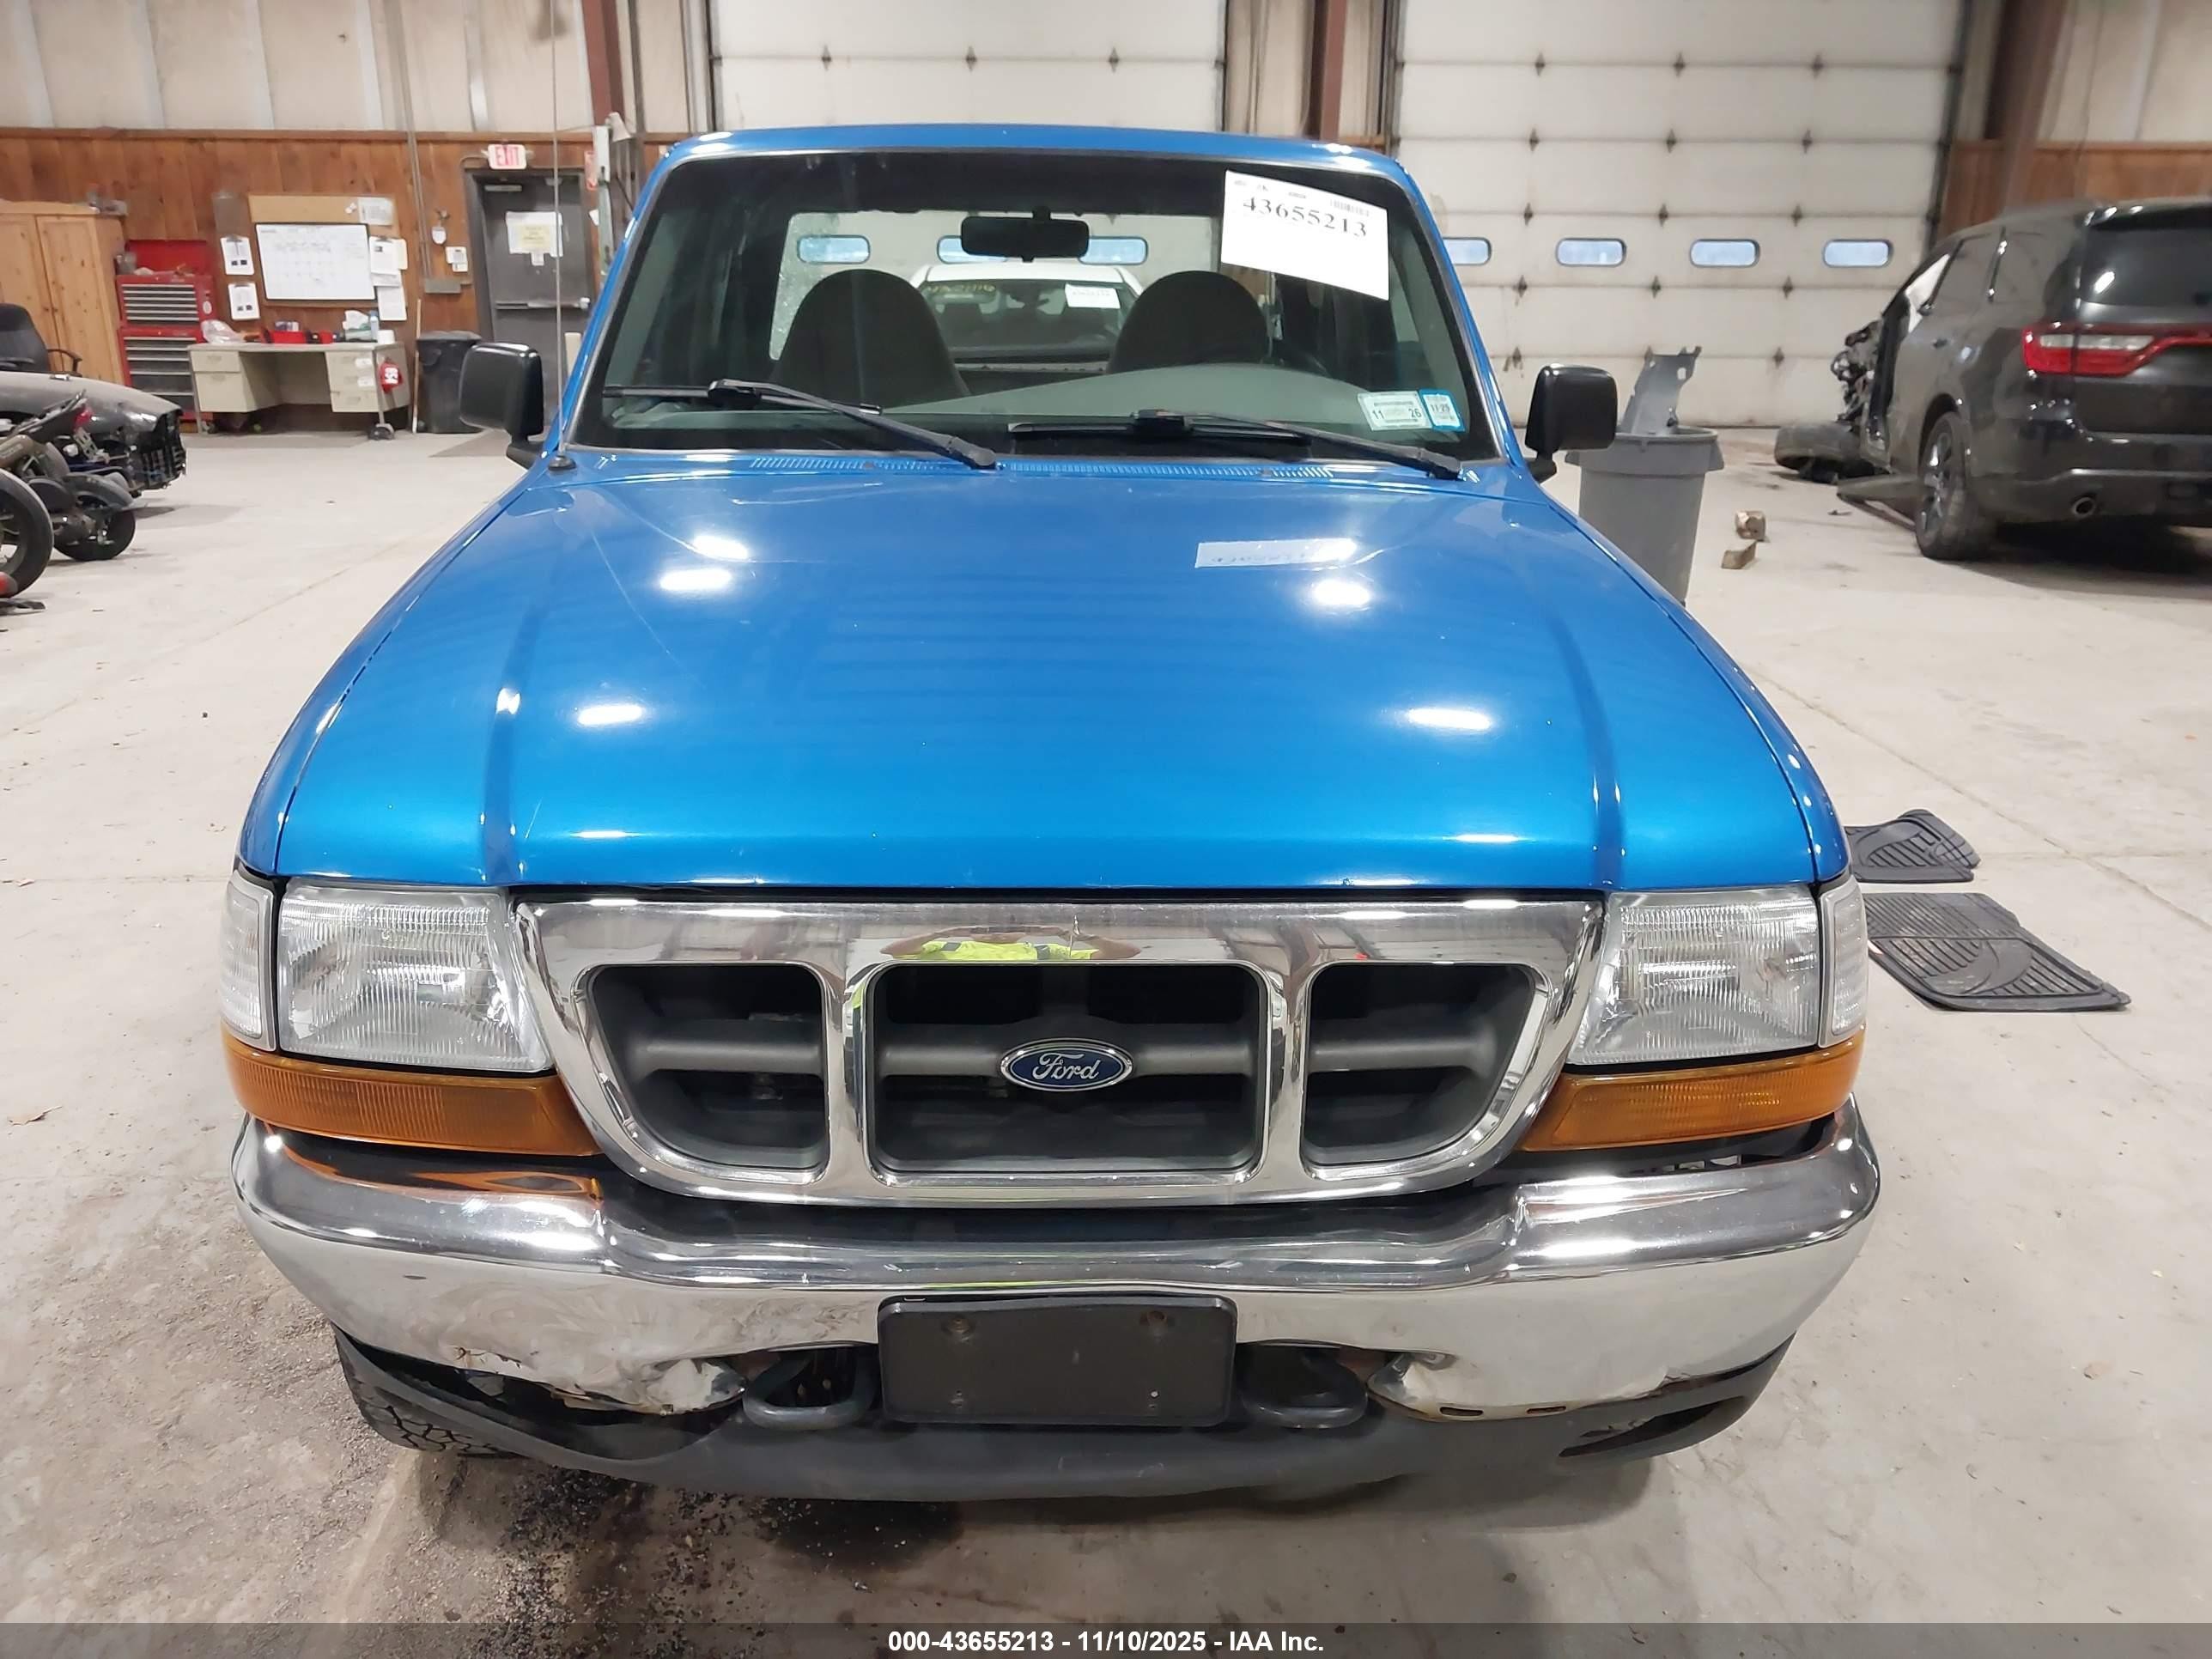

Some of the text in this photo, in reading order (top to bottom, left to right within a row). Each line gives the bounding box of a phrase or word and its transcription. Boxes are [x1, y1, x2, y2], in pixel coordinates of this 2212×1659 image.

[495, 146, 520, 167] EXIT
[1243, 197, 1367, 238] 43655213
[1032, 1052, 1101, 1079] Ford
